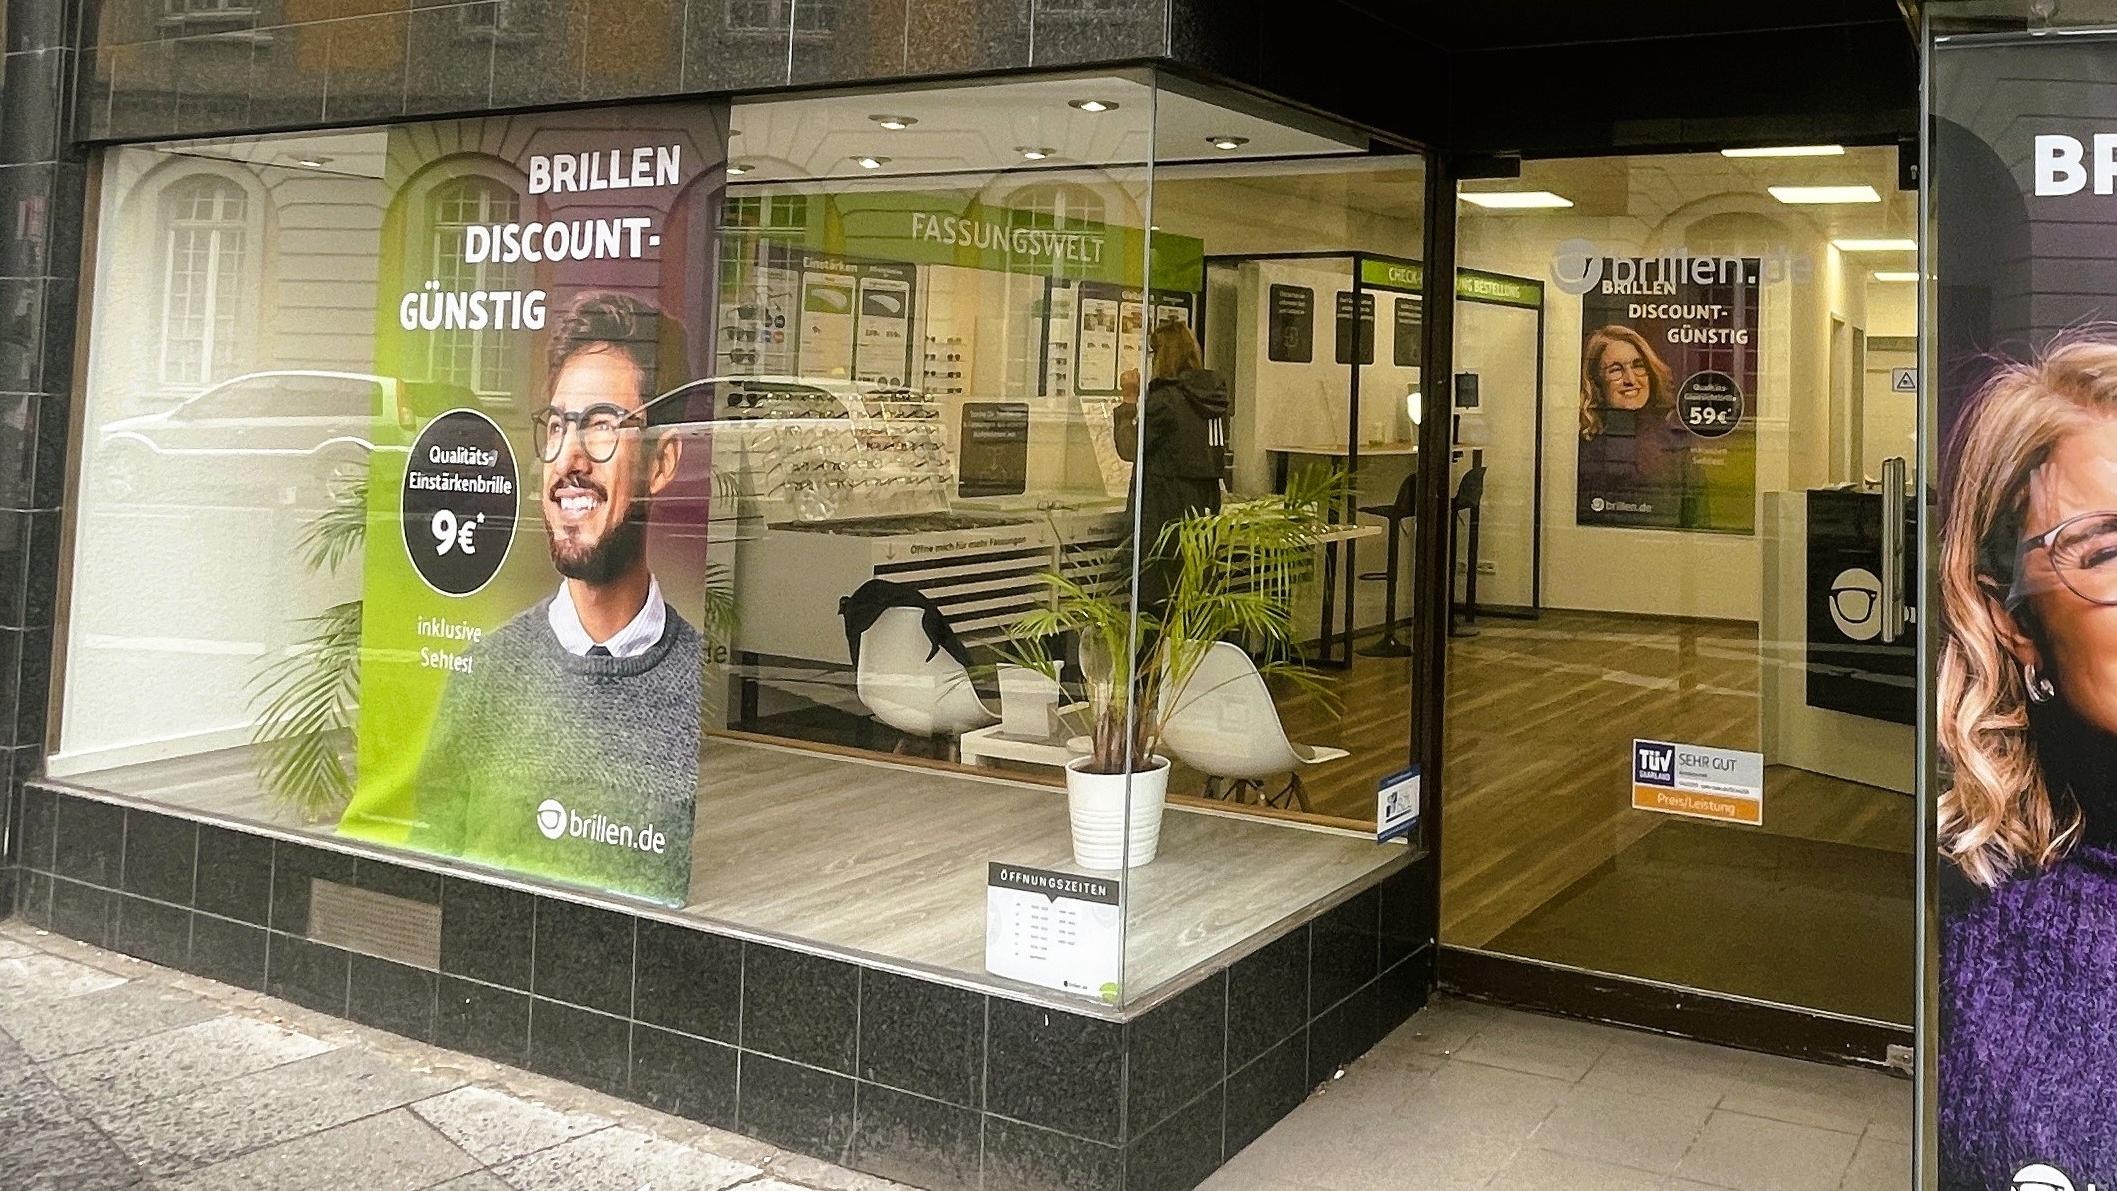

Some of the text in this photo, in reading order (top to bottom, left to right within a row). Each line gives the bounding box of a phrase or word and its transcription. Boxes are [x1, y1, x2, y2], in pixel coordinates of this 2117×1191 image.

[529, 145, 681, 194] BRILLEN
[465, 218, 660, 263] DISCOUNT-
[912, 212, 1104, 263] FASSUNGSWELT
[1601, 279, 1677, 296] BRILLEN
[400, 280, 547, 331] GÜNSTIG
[1628, 304, 1728, 320] DISCOUNT-
[1667, 324, 1749, 344] GÜNSTIG
[429, 445, 498, 467] Qualitäts-
[409, 471, 512, 495] Einstärkenbrille
[417, 616, 482, 642] inklusive
[420, 647, 474, 674] Sehtest
[1679, 753, 1738, 772] SEHR GUT
[1657, 792, 1736, 817] Preis/Leistung
[569, 788, 666, 854] brillen.de
[1000, 869, 1107, 896] ÖFFNUNGSZEITEN
